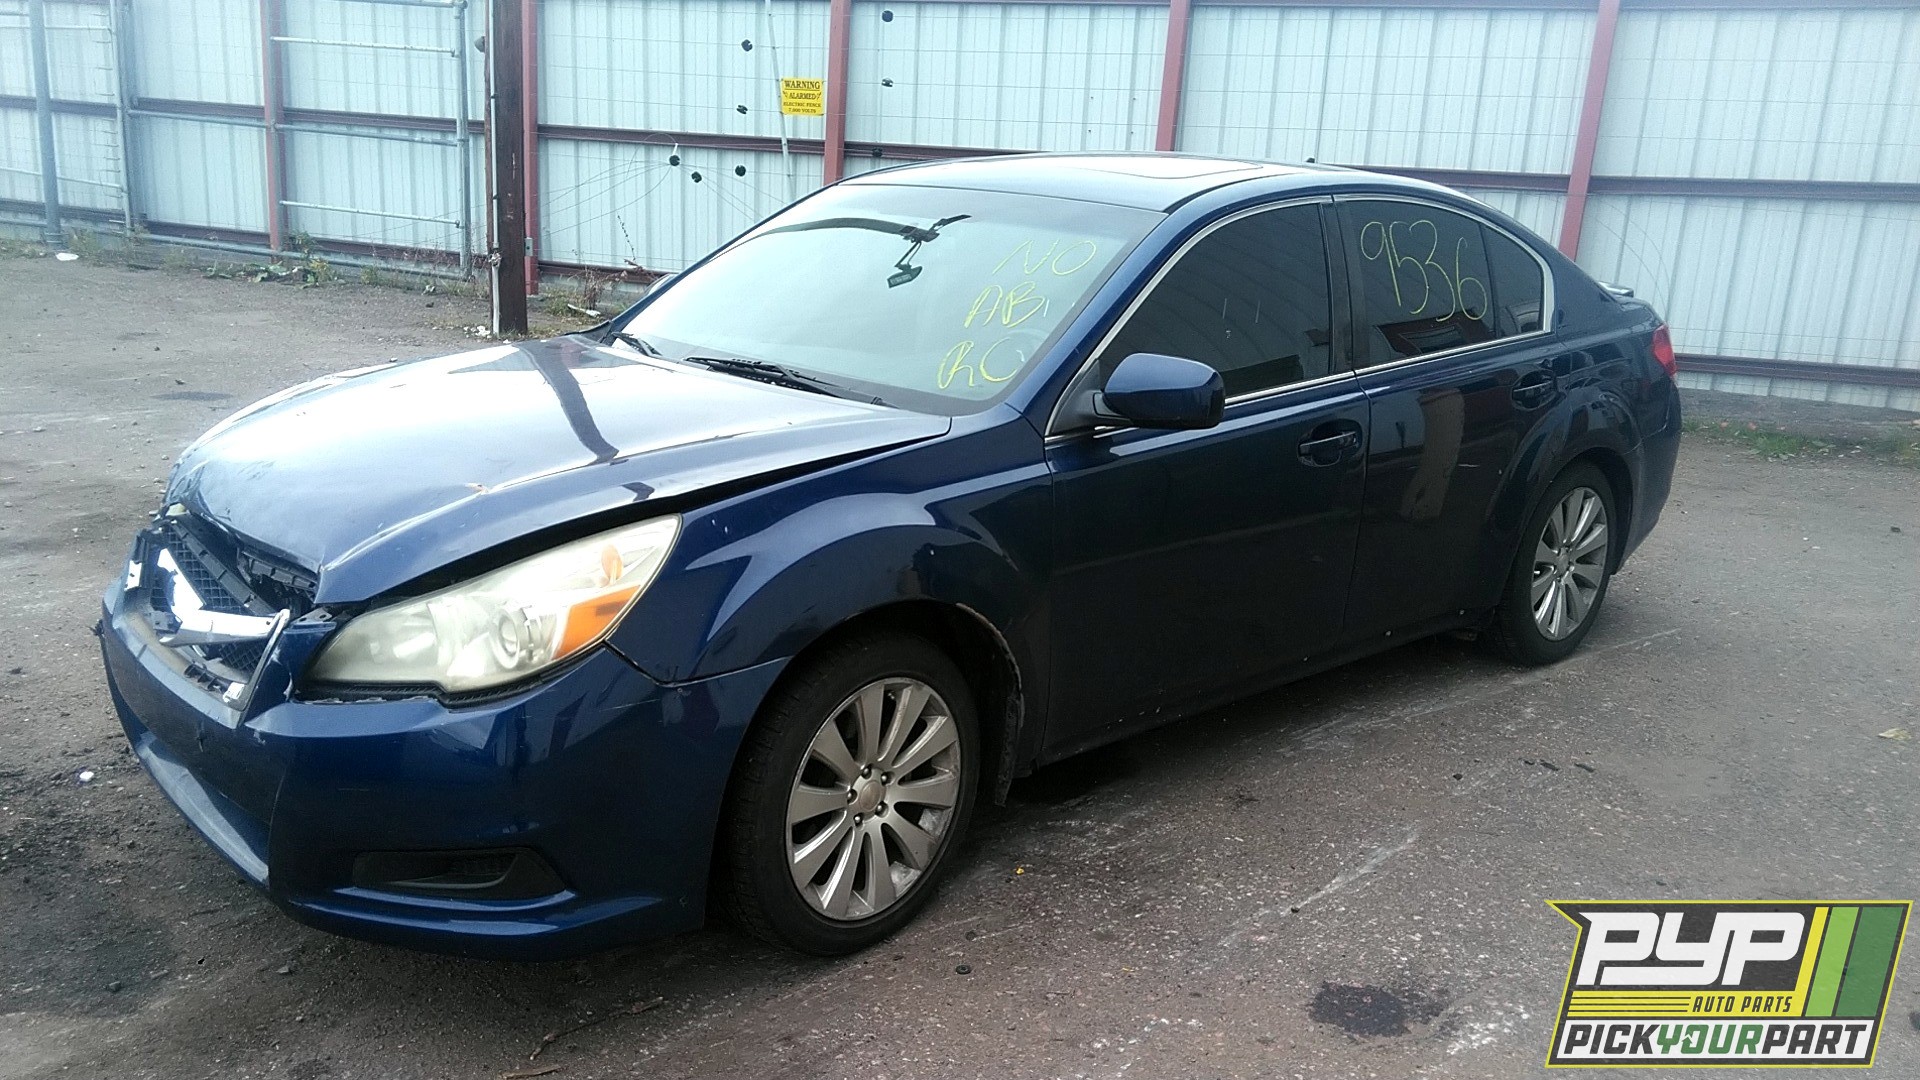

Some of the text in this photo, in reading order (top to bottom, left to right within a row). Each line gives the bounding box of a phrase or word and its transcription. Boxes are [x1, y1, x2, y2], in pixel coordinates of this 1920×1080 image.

[784, 80, 820, 89] WARNING
[789, 92, 816, 100] ALARMED
[992, 240, 1096, 275] NO
[1361, 220, 1488, 322] 9536
